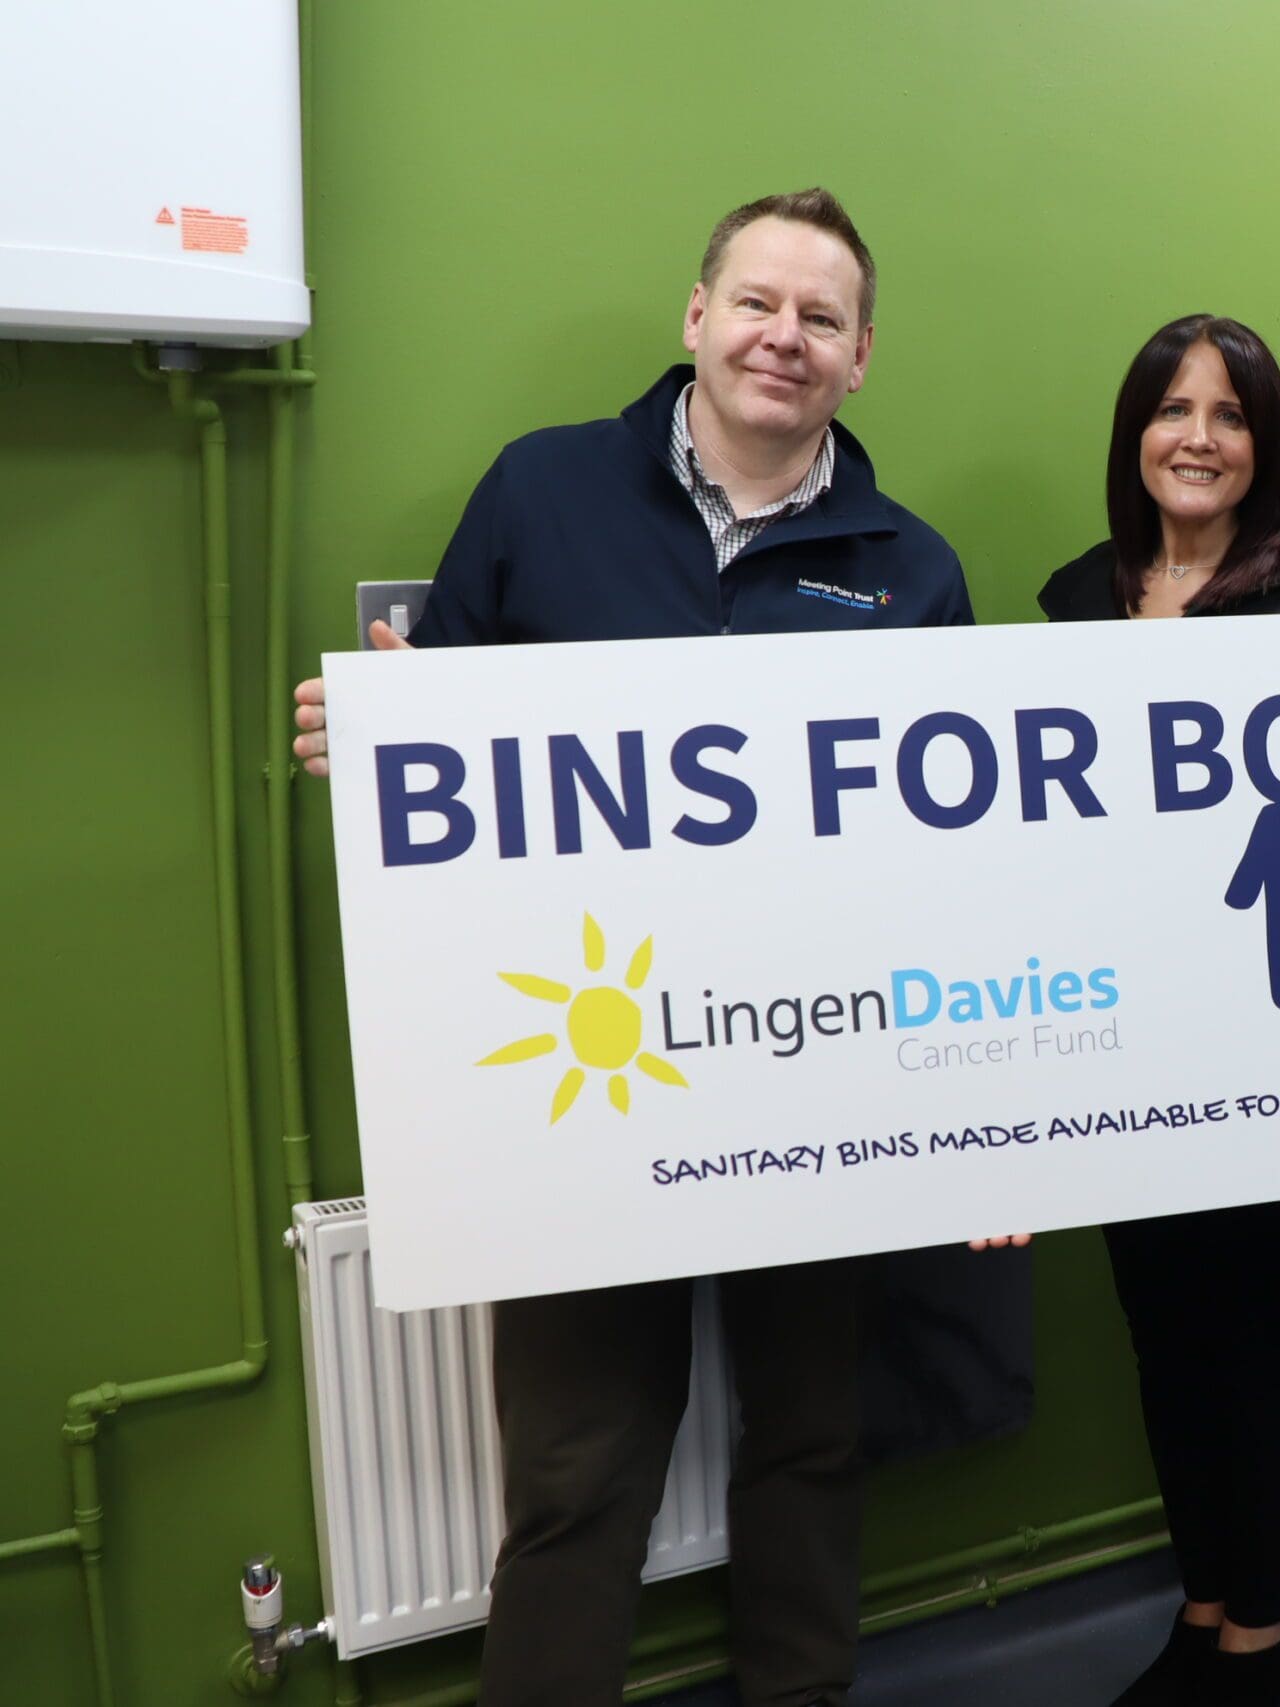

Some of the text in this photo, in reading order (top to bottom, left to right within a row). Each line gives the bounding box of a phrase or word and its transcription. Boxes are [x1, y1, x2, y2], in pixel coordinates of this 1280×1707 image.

[798, 577, 874, 603] Meeting Point Trust
[374, 723, 758, 867] BINS
[806, 706, 1108, 837] FOR
[660, 957, 1120, 1057] LingenDavies
[896, 1018, 1124, 1071] Cancer Fund
[651, 1144, 825, 1186] SANITARY
[837, 1132, 920, 1168] BINS
[929, 1121, 1039, 1154] MADE
[1047, 1099, 1230, 1141] AVAILABLE
